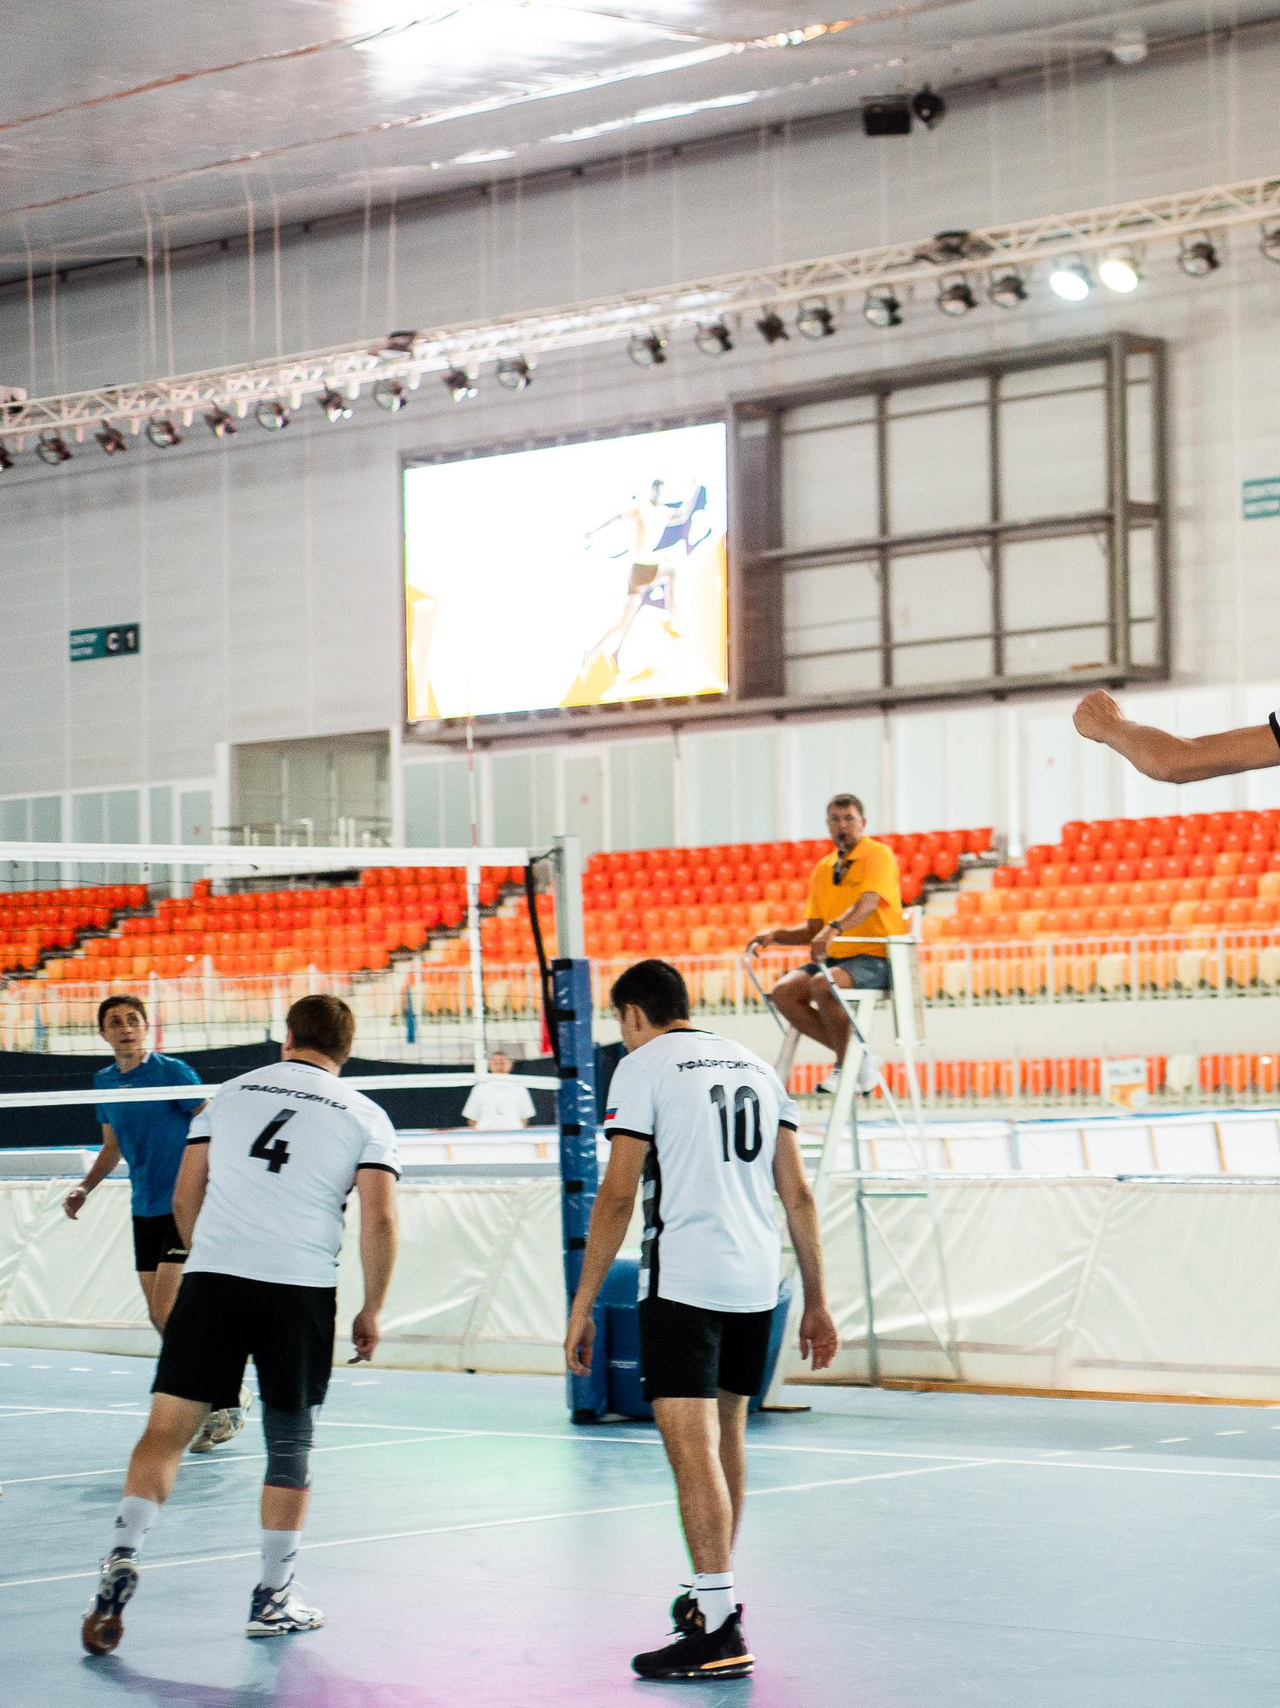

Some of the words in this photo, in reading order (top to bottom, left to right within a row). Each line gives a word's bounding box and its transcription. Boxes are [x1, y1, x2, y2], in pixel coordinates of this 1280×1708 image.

[126, 630, 135, 649] 1
[249, 1108, 298, 1174] 4
[709, 1084, 763, 1163] 10
